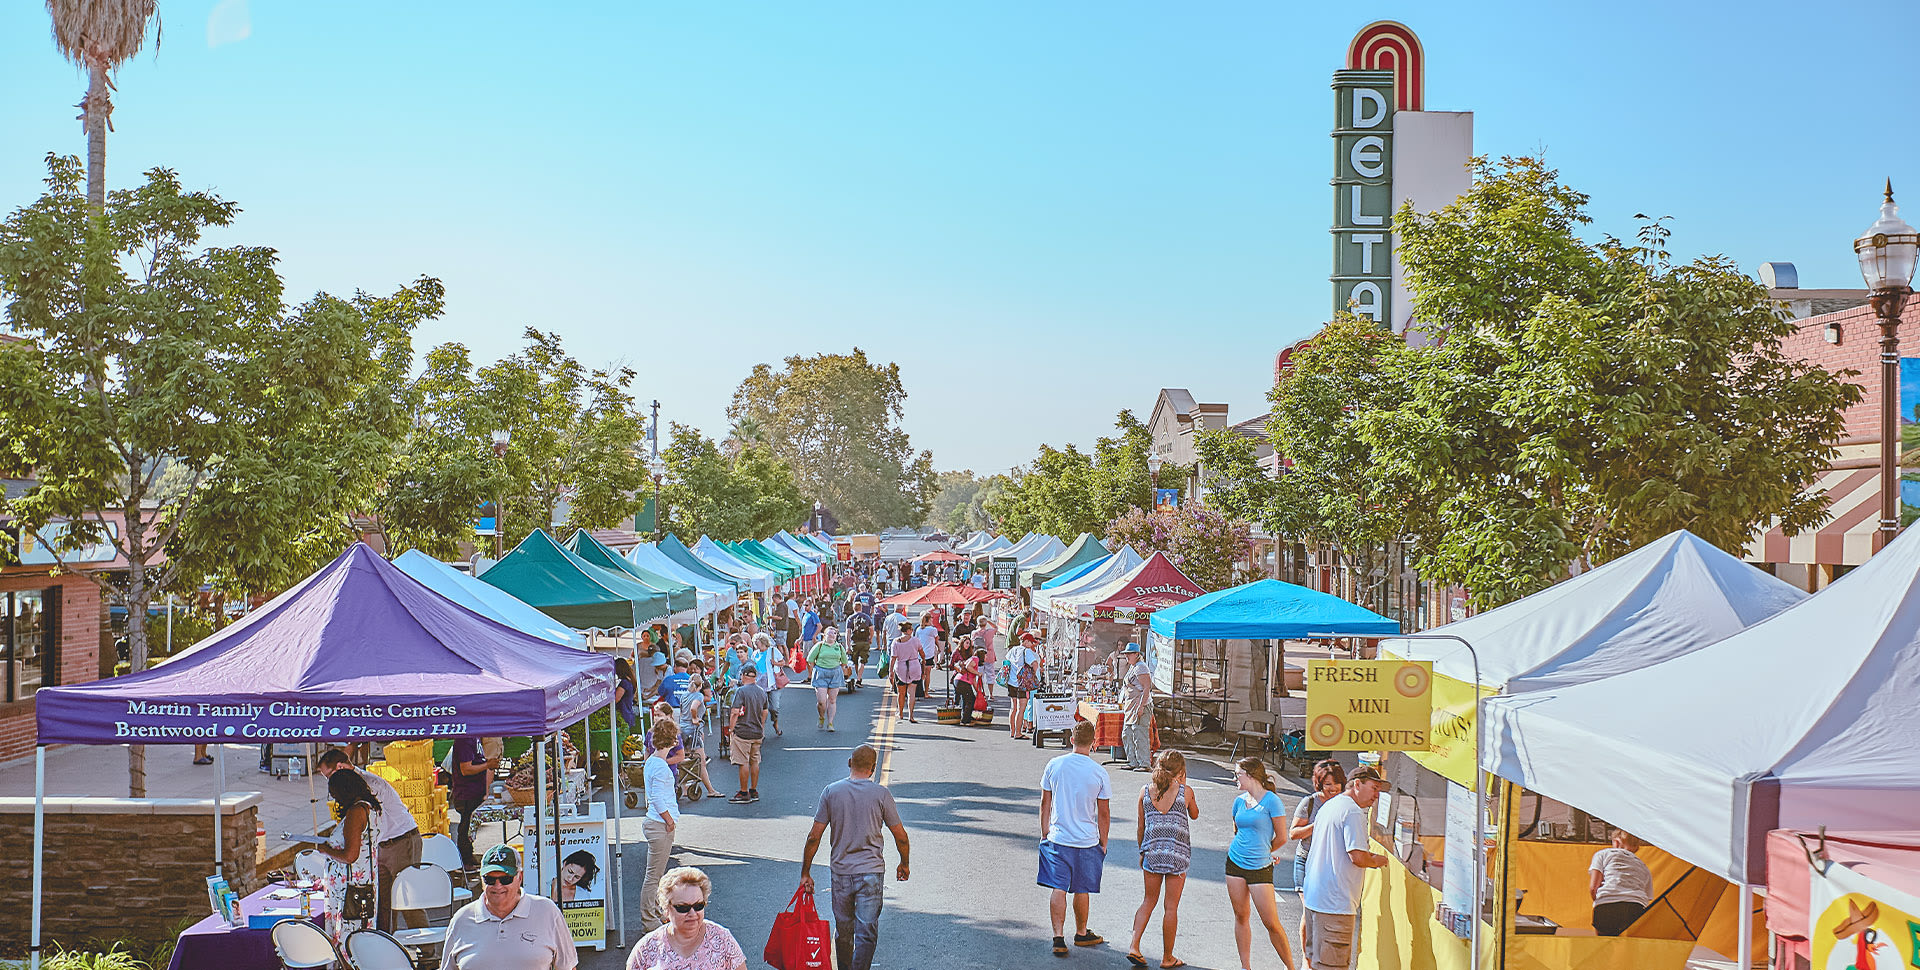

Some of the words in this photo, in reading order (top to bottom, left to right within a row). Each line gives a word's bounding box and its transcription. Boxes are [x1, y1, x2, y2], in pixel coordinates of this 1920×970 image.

[1350, 88, 1387, 322] DELTA
[1133, 583, 1200, 598] Breakfast
[1093, 609, 1125, 619] BAKED
[1314, 667, 1378, 682] FRESH
[127, 700, 192, 717] Martin
[197, 703, 264, 721] Family
[269, 702, 383, 722] Chiropractic
[387, 703, 457, 718] Centers
[1348, 698, 1390, 713] MINI
[114, 721, 218, 737] Brentwood
[242, 723, 323, 737] Concord
[347, 725, 426, 737] Pleasant
[430, 724, 467, 735] Hill
[1348, 730, 1424, 745] DONUTS
[568, 835, 600, 845] nerve??
[563, 911, 600, 921] iropractic
[572, 928, 596, 937] NOW!
